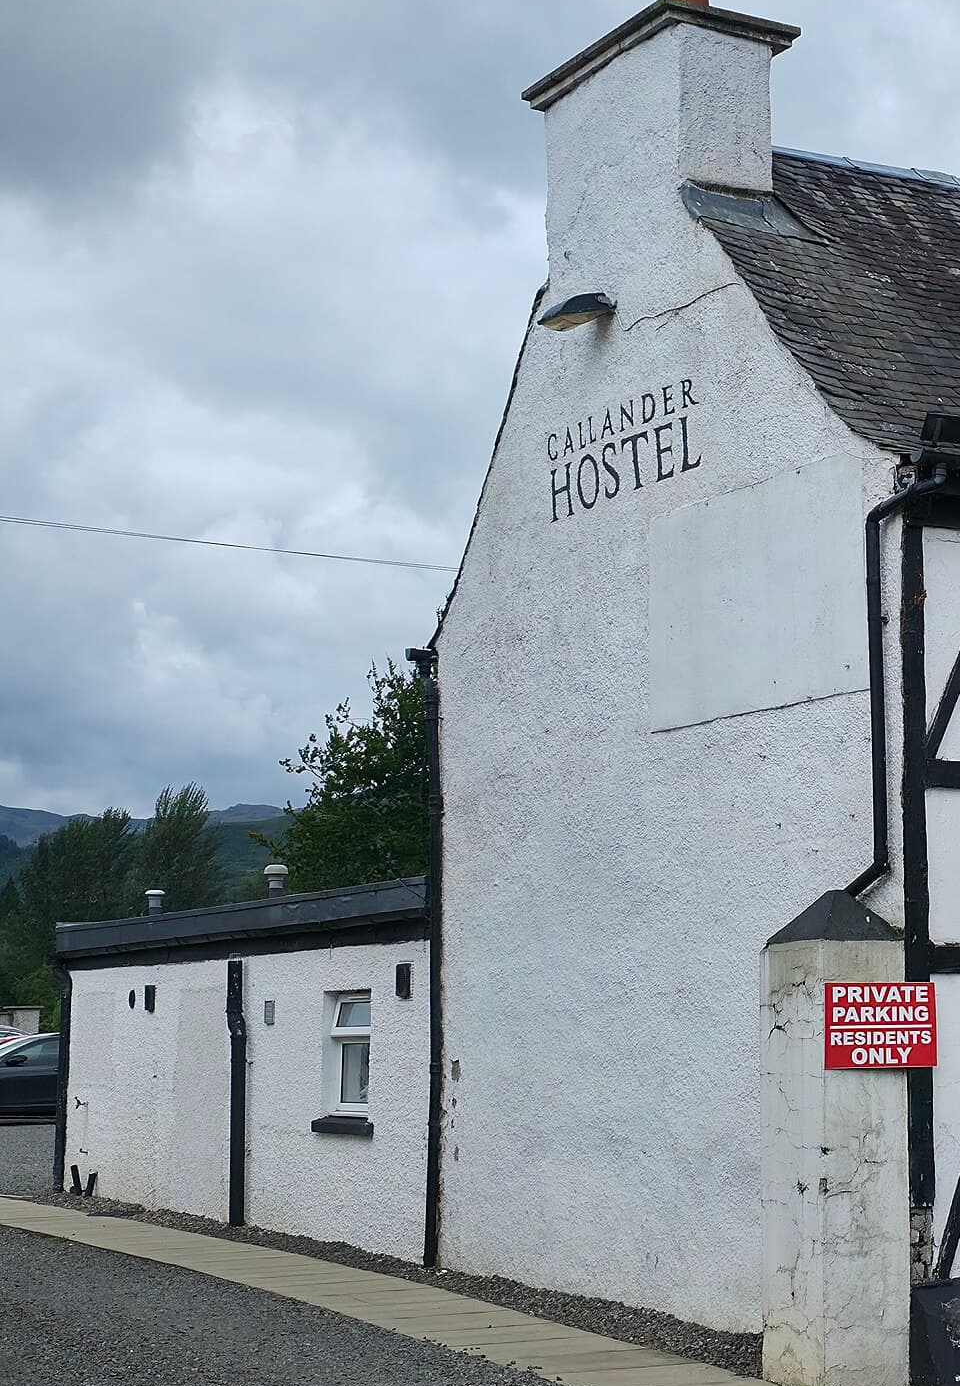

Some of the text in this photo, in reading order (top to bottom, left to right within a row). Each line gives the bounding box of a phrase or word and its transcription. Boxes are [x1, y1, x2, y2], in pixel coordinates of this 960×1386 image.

[547, 378, 700, 461] CALLANDER
[550, 416, 702, 523] HOSTEL
[832, 986, 929, 1003] PRIVATE
[832, 1006, 929, 1023] PARKING
[830, 1030, 932, 1046] RESIDENTS
[851, 1047, 912, 1065] ONLY
